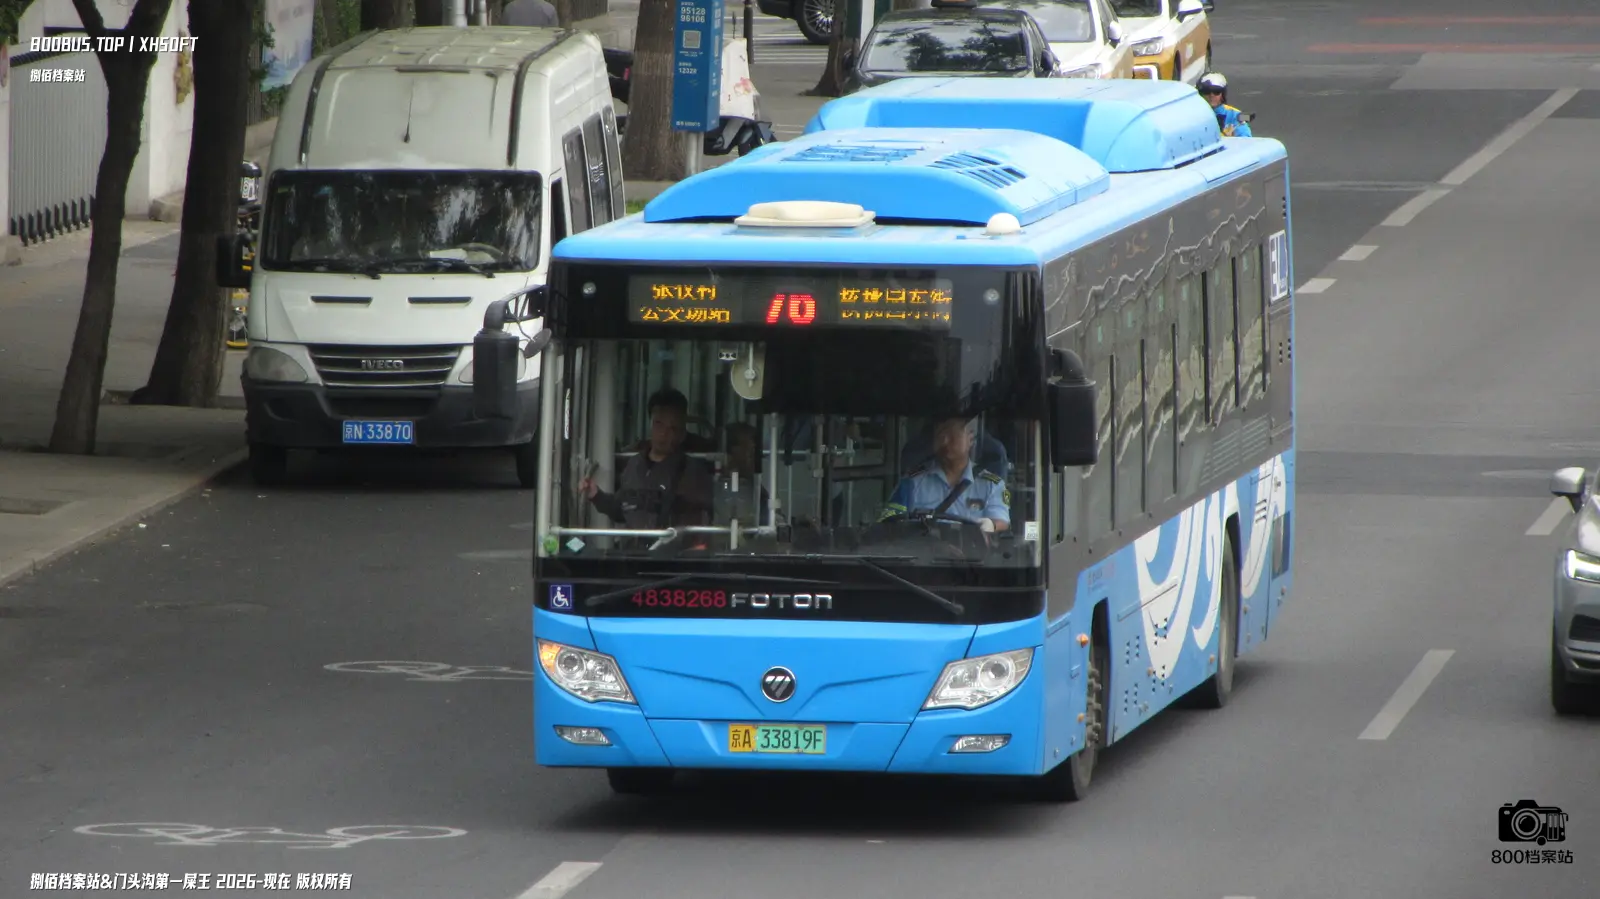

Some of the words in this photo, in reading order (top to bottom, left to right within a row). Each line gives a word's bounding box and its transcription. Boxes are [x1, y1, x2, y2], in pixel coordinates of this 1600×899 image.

[681, 7, 706, 15] 95128
[680, 15, 706, 23] 96106
[361, 359, 404, 370] IVECO
[632, 589, 727, 608] 4838268
